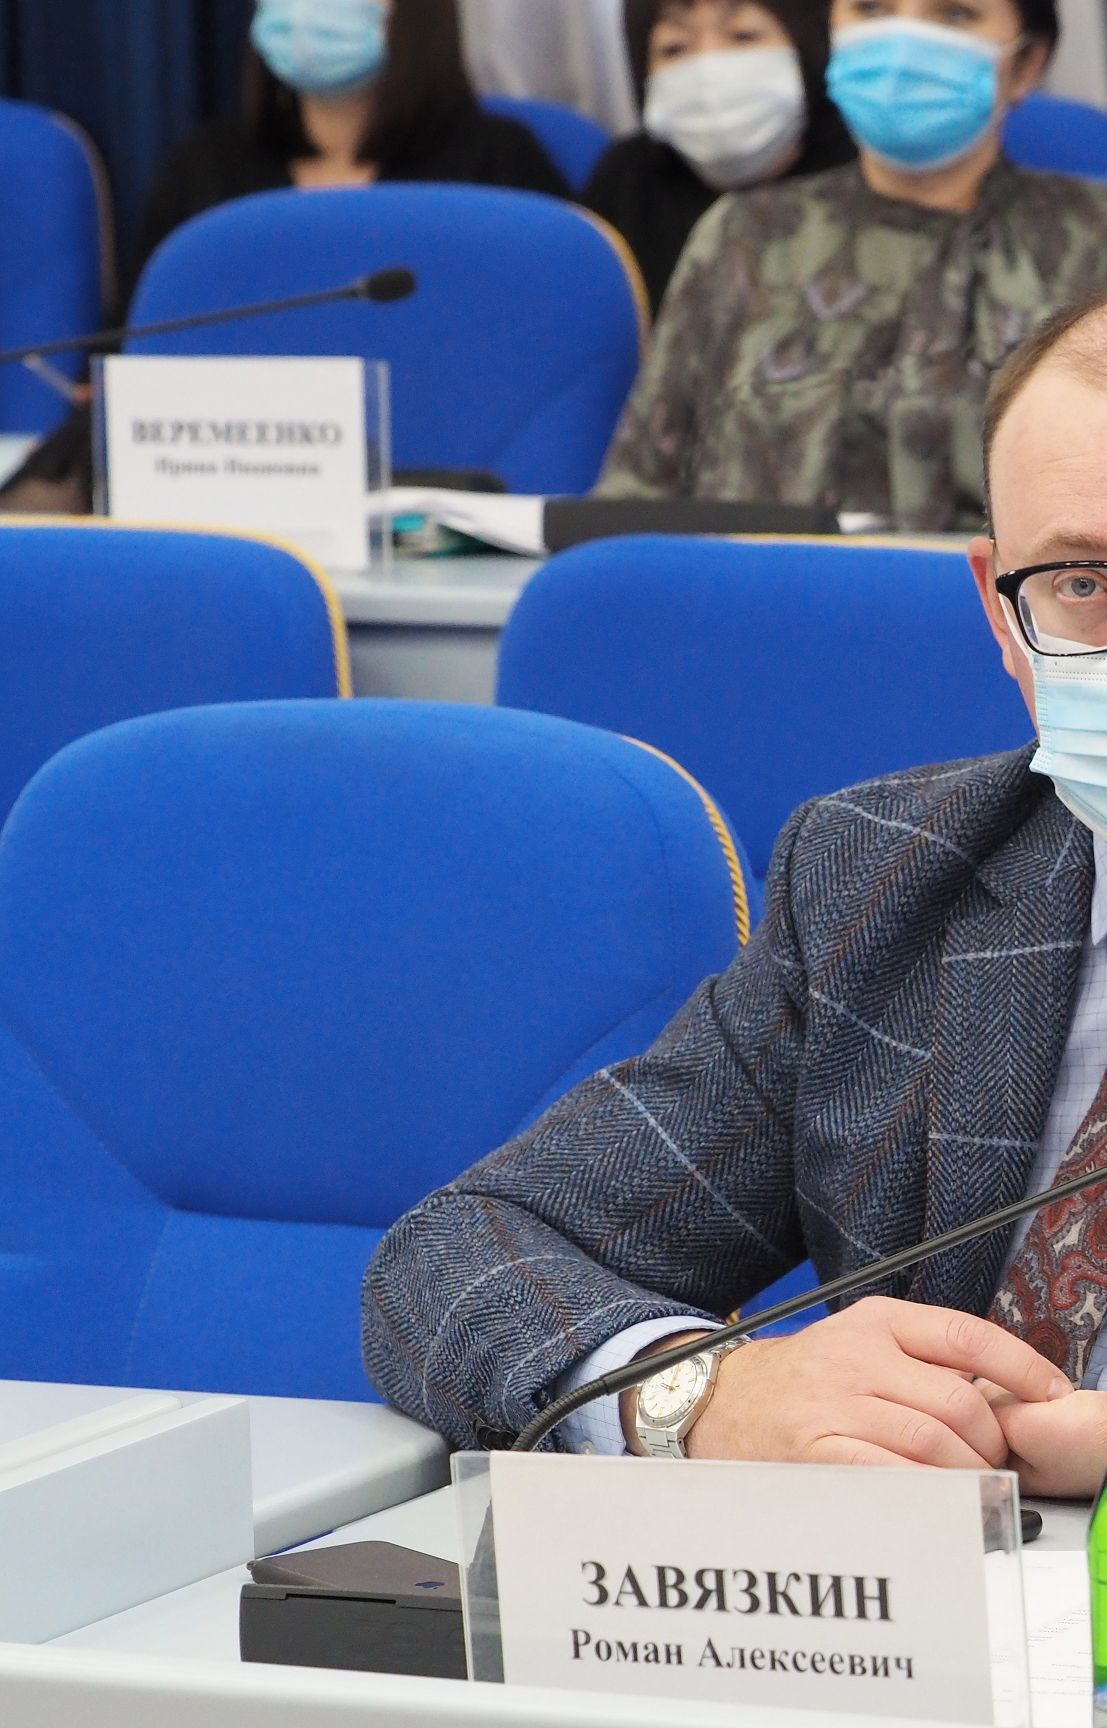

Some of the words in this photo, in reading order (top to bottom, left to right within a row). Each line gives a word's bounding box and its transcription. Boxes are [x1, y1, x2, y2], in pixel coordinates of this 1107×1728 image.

[132, 419, 343, 445] ВЕРЕМЕЕНКО
[581, 1560, 893, 1621] ЗАВЯЗКИН
[571, 1628, 684, 1666] Роман
[698, 1636, 914, 1679] Алексеевич
